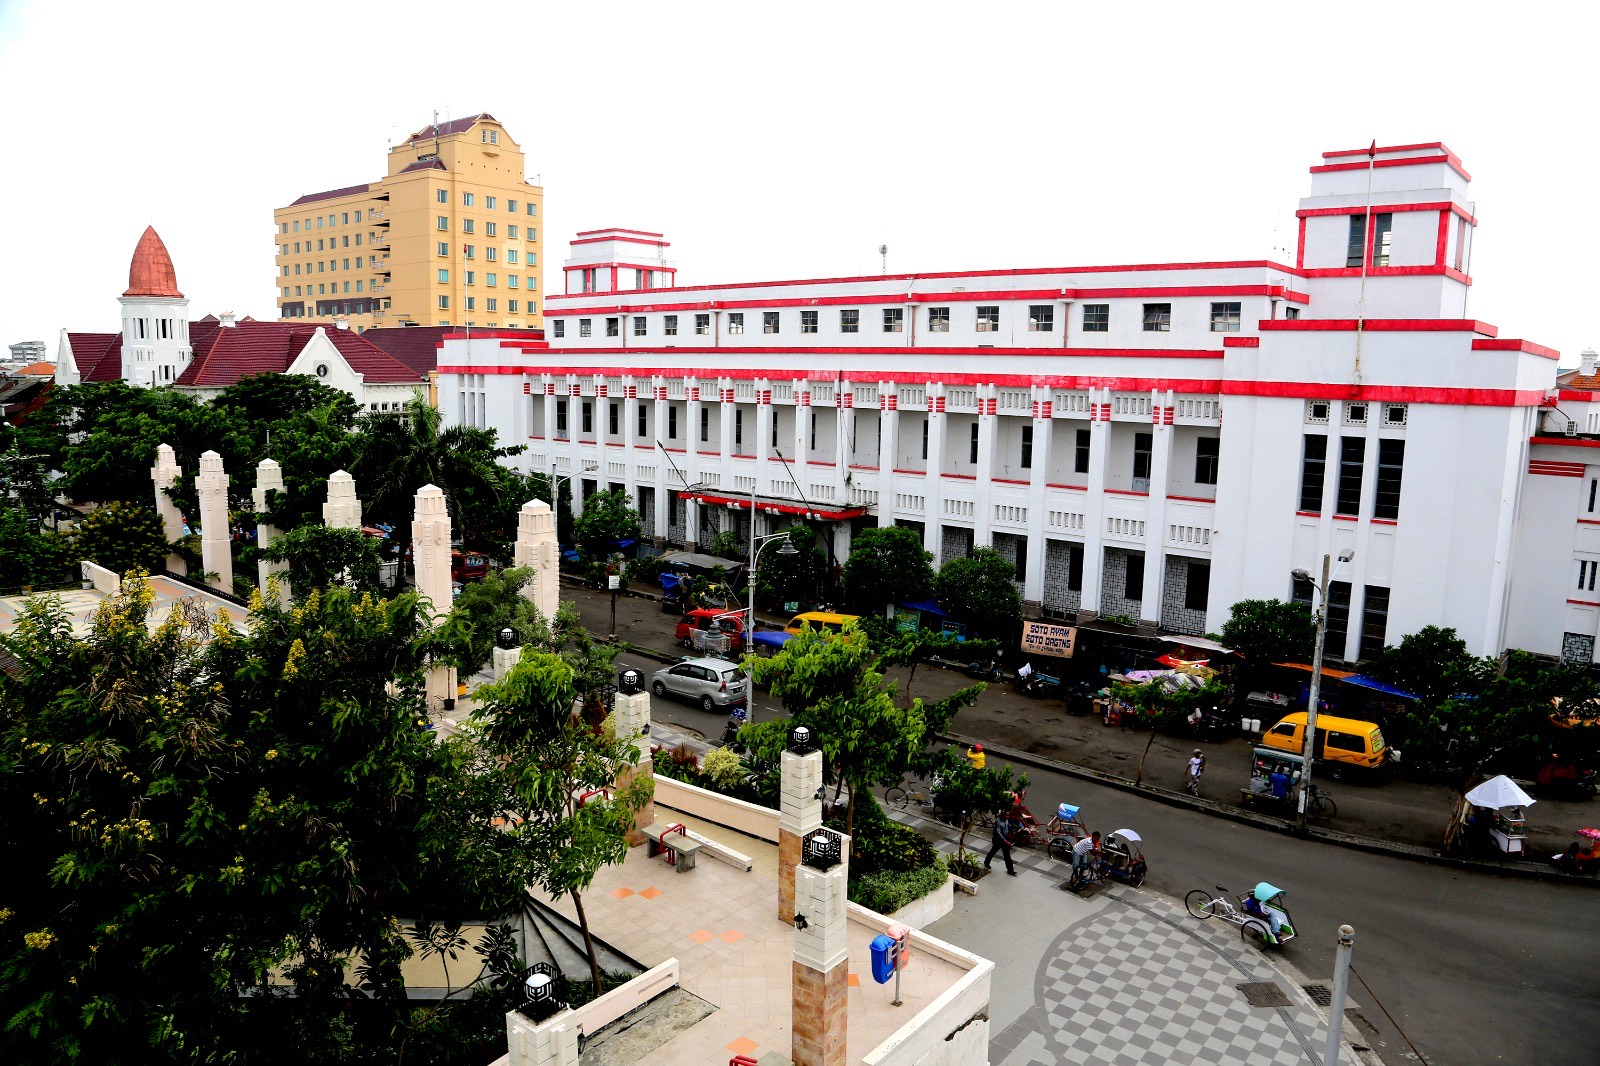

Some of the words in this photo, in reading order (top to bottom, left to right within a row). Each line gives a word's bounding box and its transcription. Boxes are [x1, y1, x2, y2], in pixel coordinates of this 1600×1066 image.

[1030, 625, 1048, 635] SOTO
[1050, 627, 1069, 637] AYAM
[1026, 634, 1043, 644] SOTO
